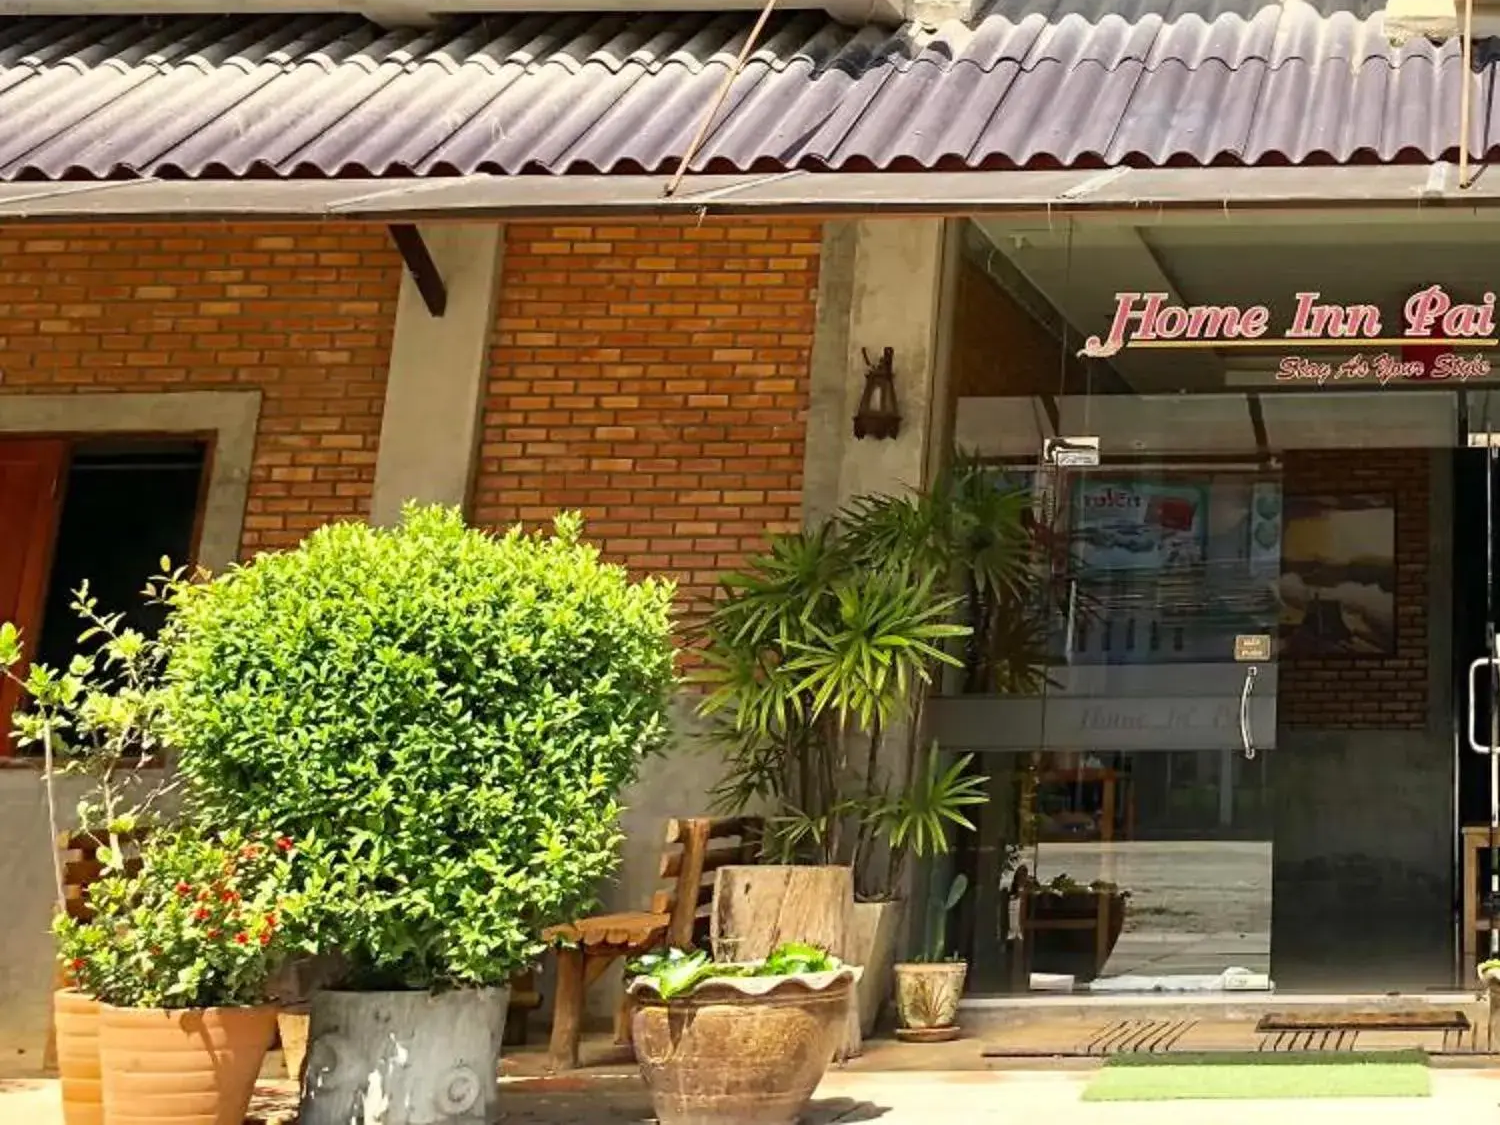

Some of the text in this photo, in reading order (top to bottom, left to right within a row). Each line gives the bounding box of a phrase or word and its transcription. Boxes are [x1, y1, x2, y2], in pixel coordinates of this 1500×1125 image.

[1076, 284, 1498, 358] Home Inn Pai
[1275, 352, 1492, 386] Stay As Your Style
